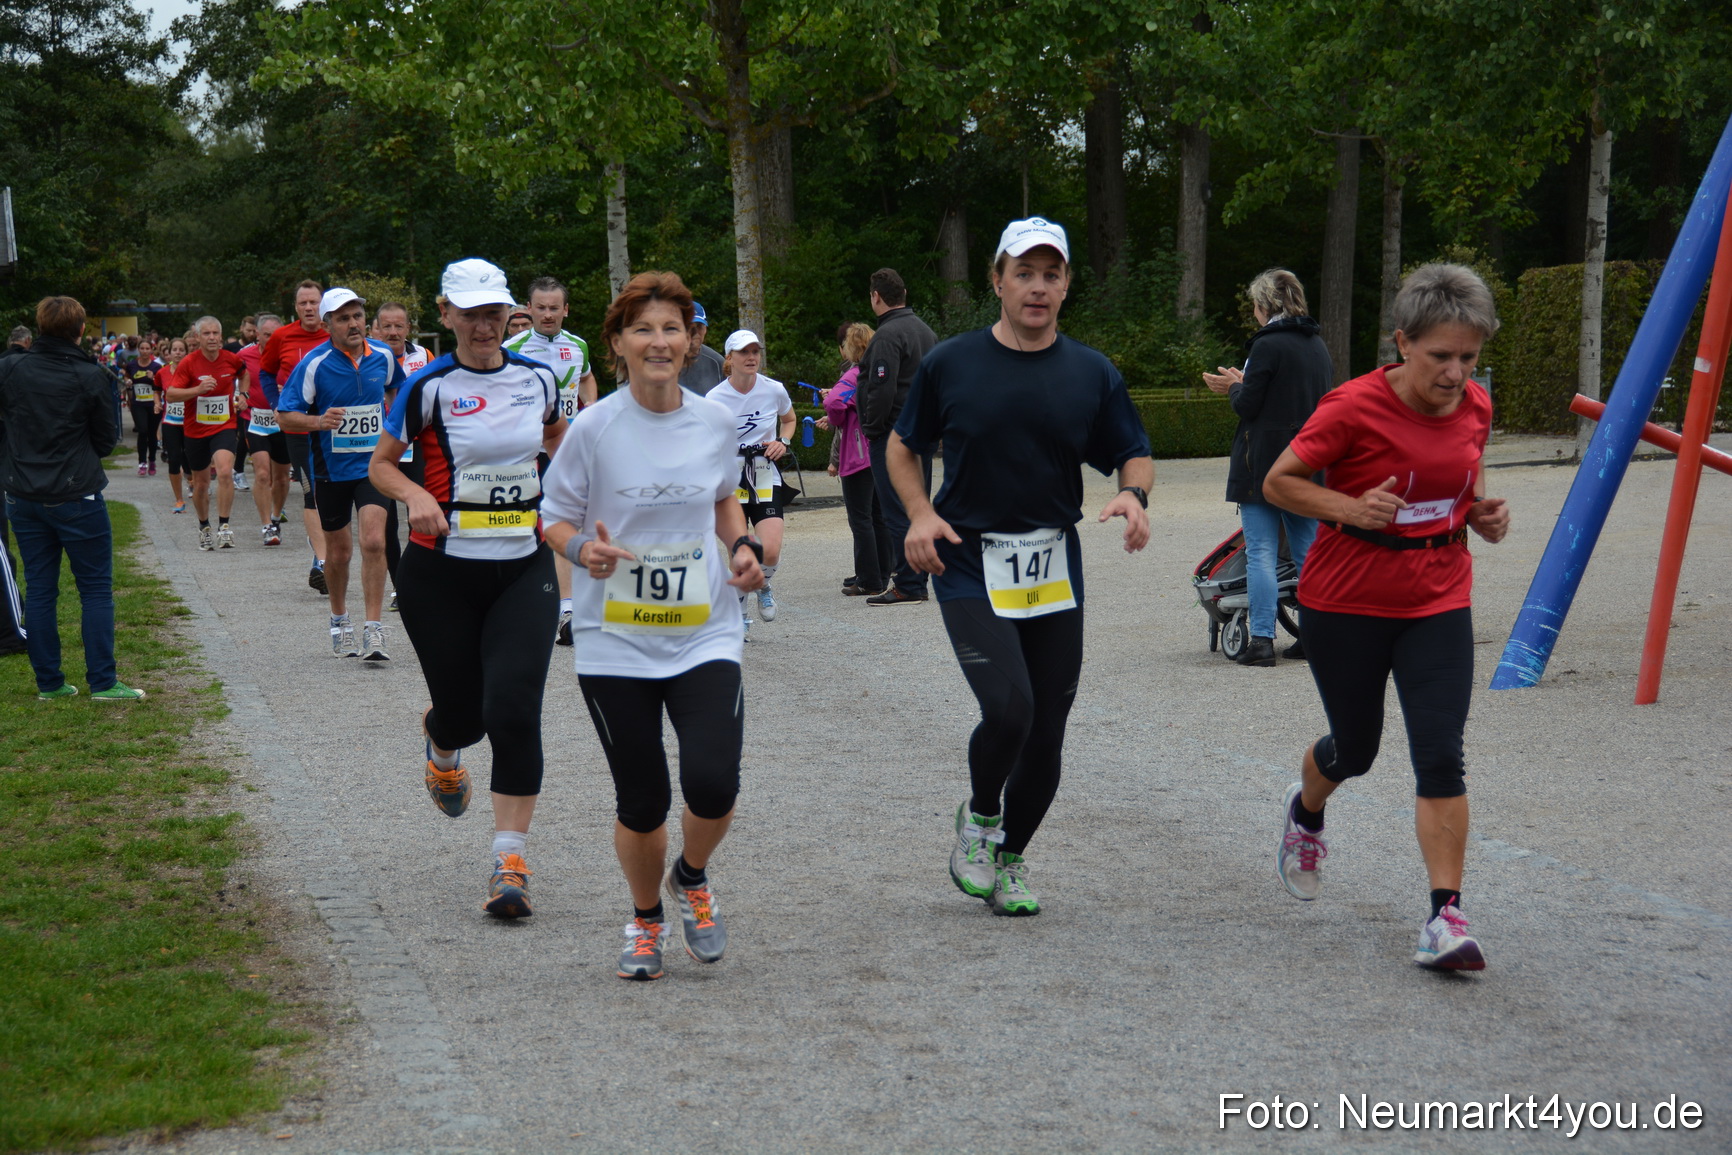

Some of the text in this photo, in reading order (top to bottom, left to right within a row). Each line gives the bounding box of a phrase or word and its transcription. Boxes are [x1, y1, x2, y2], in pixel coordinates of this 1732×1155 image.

[205, 403, 224, 414] 129
[452, 397, 477, 409] tkn
[338, 415, 379, 435] 2269
[462, 472, 531, 482] PARTL Neumarkt
[489, 485, 522, 505] 63
[1412, 506, 1438, 517] DEHN
[489, 513, 521, 525] Heide
[1019, 535, 1057, 547] Neumarkt
[643, 552, 690, 563] Neumarkt
[1005, 547, 1053, 584] 147
[630, 564, 687, 602] 197
[1027, 590, 1040, 605] Uli
[633, 608, 682, 624] Kerstin
